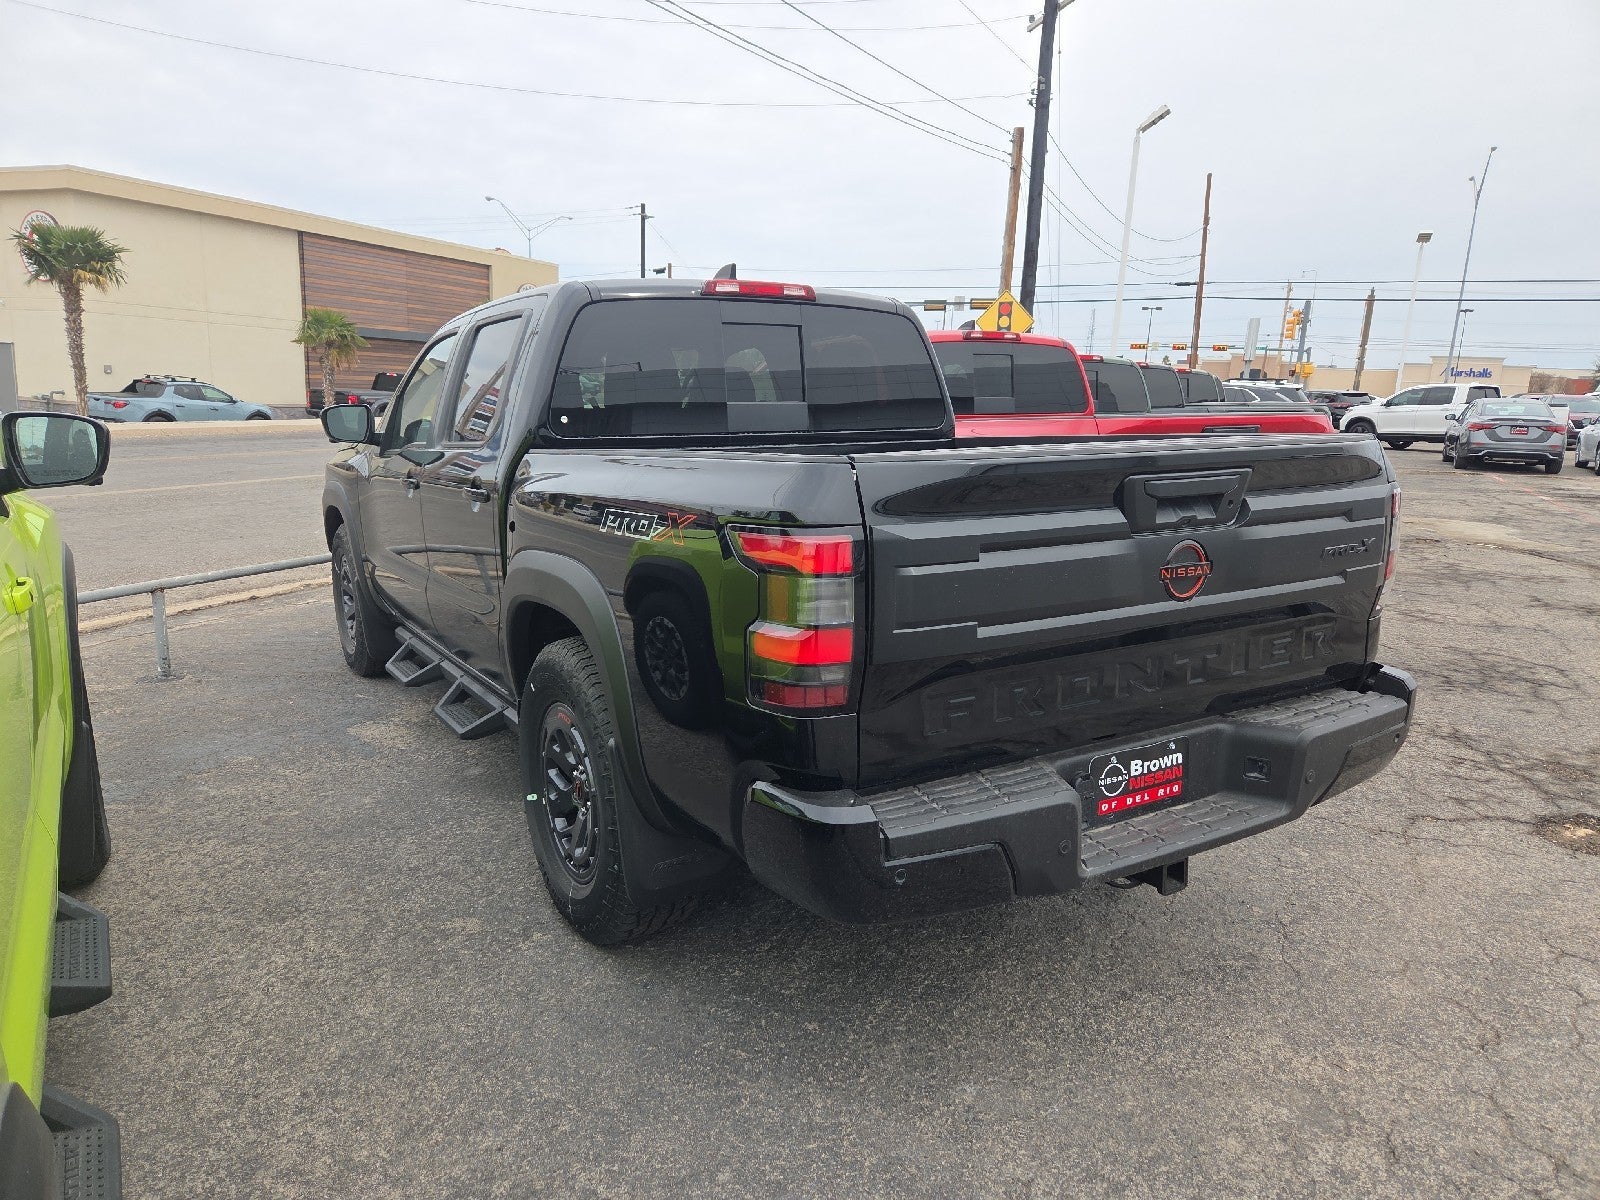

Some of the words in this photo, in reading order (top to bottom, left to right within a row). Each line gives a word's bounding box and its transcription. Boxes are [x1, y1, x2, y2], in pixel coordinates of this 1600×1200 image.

[1160, 564, 1211, 579] NISSAN
[923, 618, 1339, 736] FRONTIER
[1130, 752, 1183, 777] Brown
[1098, 774, 1129, 786] NISSAN
[1129, 765, 1183, 790] NISSAN
[1101, 800, 1118, 812] OF
[1126, 793, 1150, 806] DEL
[1157, 784, 1180, 797] RIO
